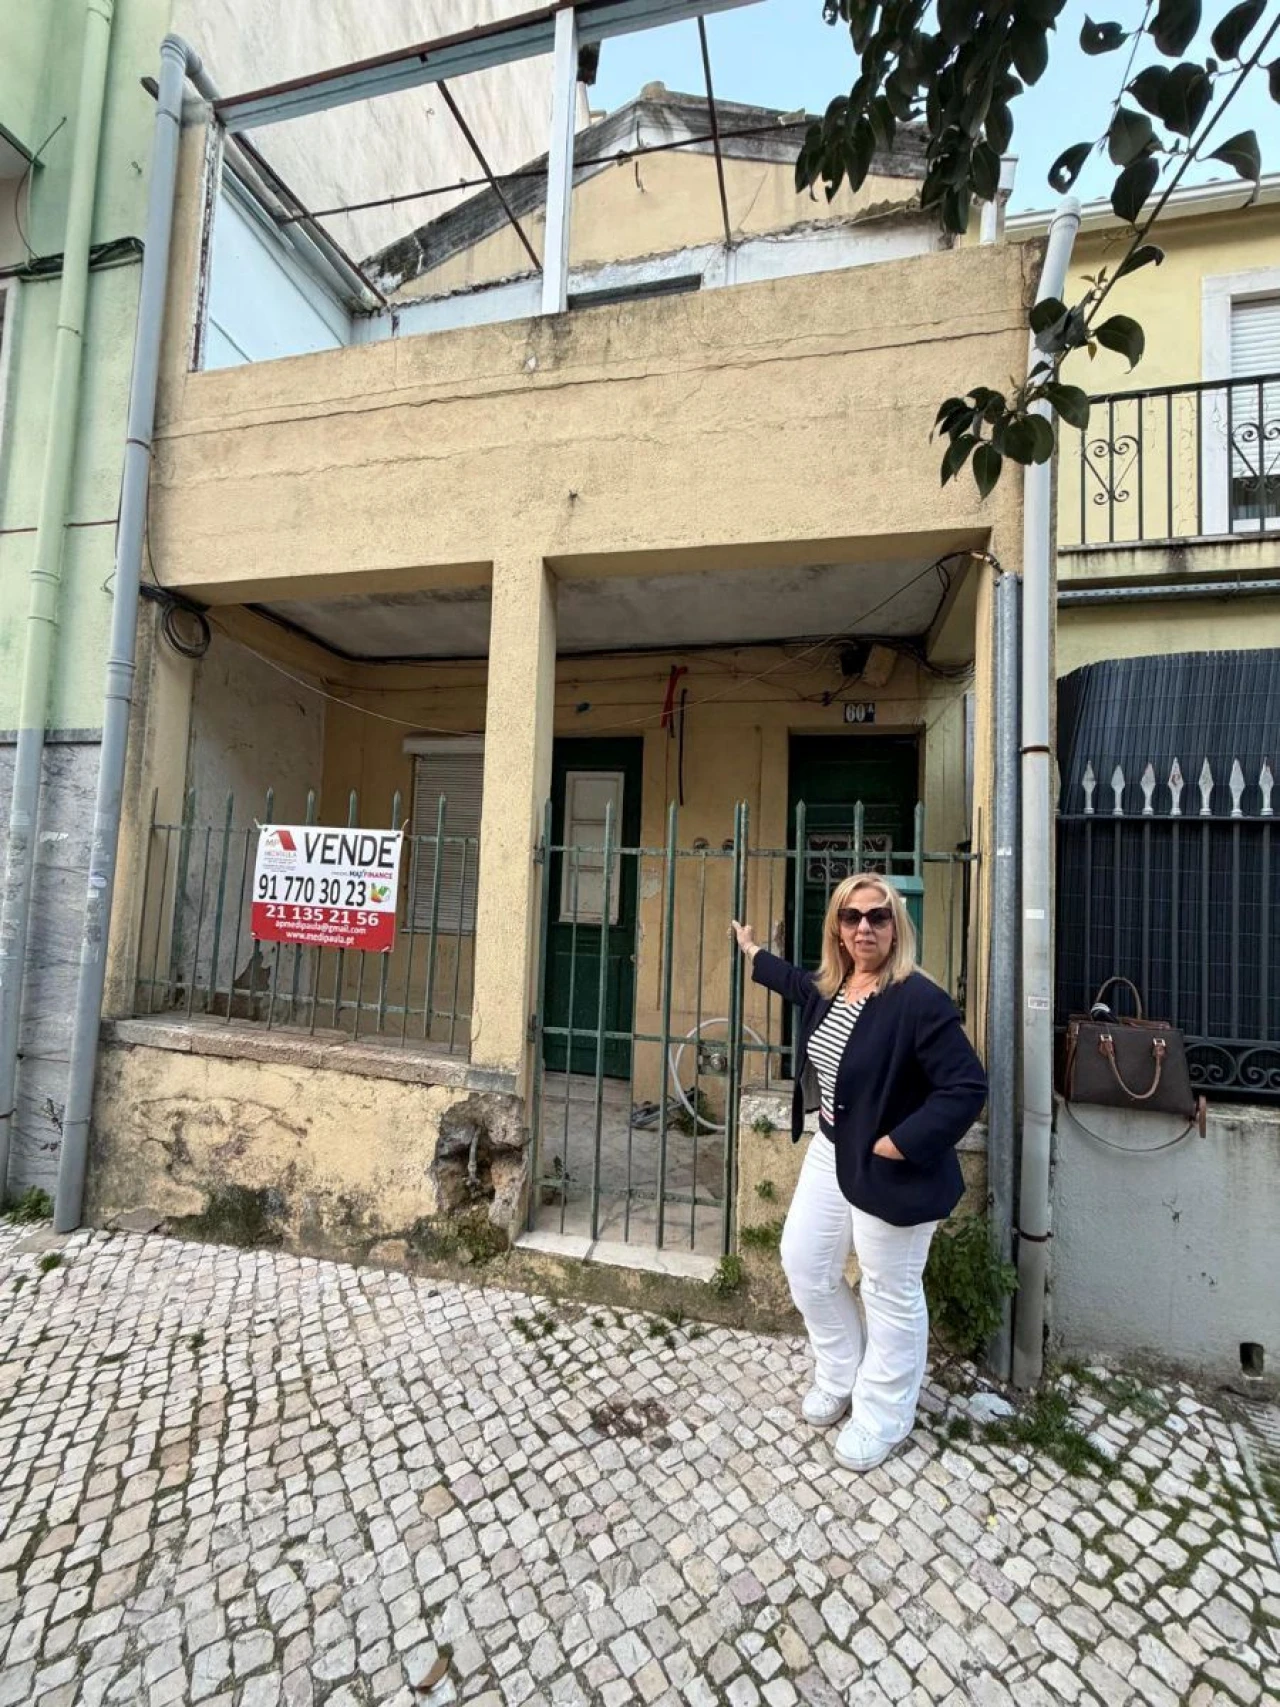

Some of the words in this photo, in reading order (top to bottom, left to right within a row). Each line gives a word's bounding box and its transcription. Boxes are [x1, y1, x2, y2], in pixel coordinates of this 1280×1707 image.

[304, 832, 396, 868] VENDE
[258, 874, 277, 899] 91
[284, 875, 314, 903] 770
[319, 878, 341, 905] 30
[345, 879, 367, 906] 23
[265, 904, 286, 918] 21
[292, 906, 323, 921] 135
[329, 910, 350, 924] 21
[356, 911, 379, 926] 56
[285, 931, 354, 945] www.medipaula.pt
